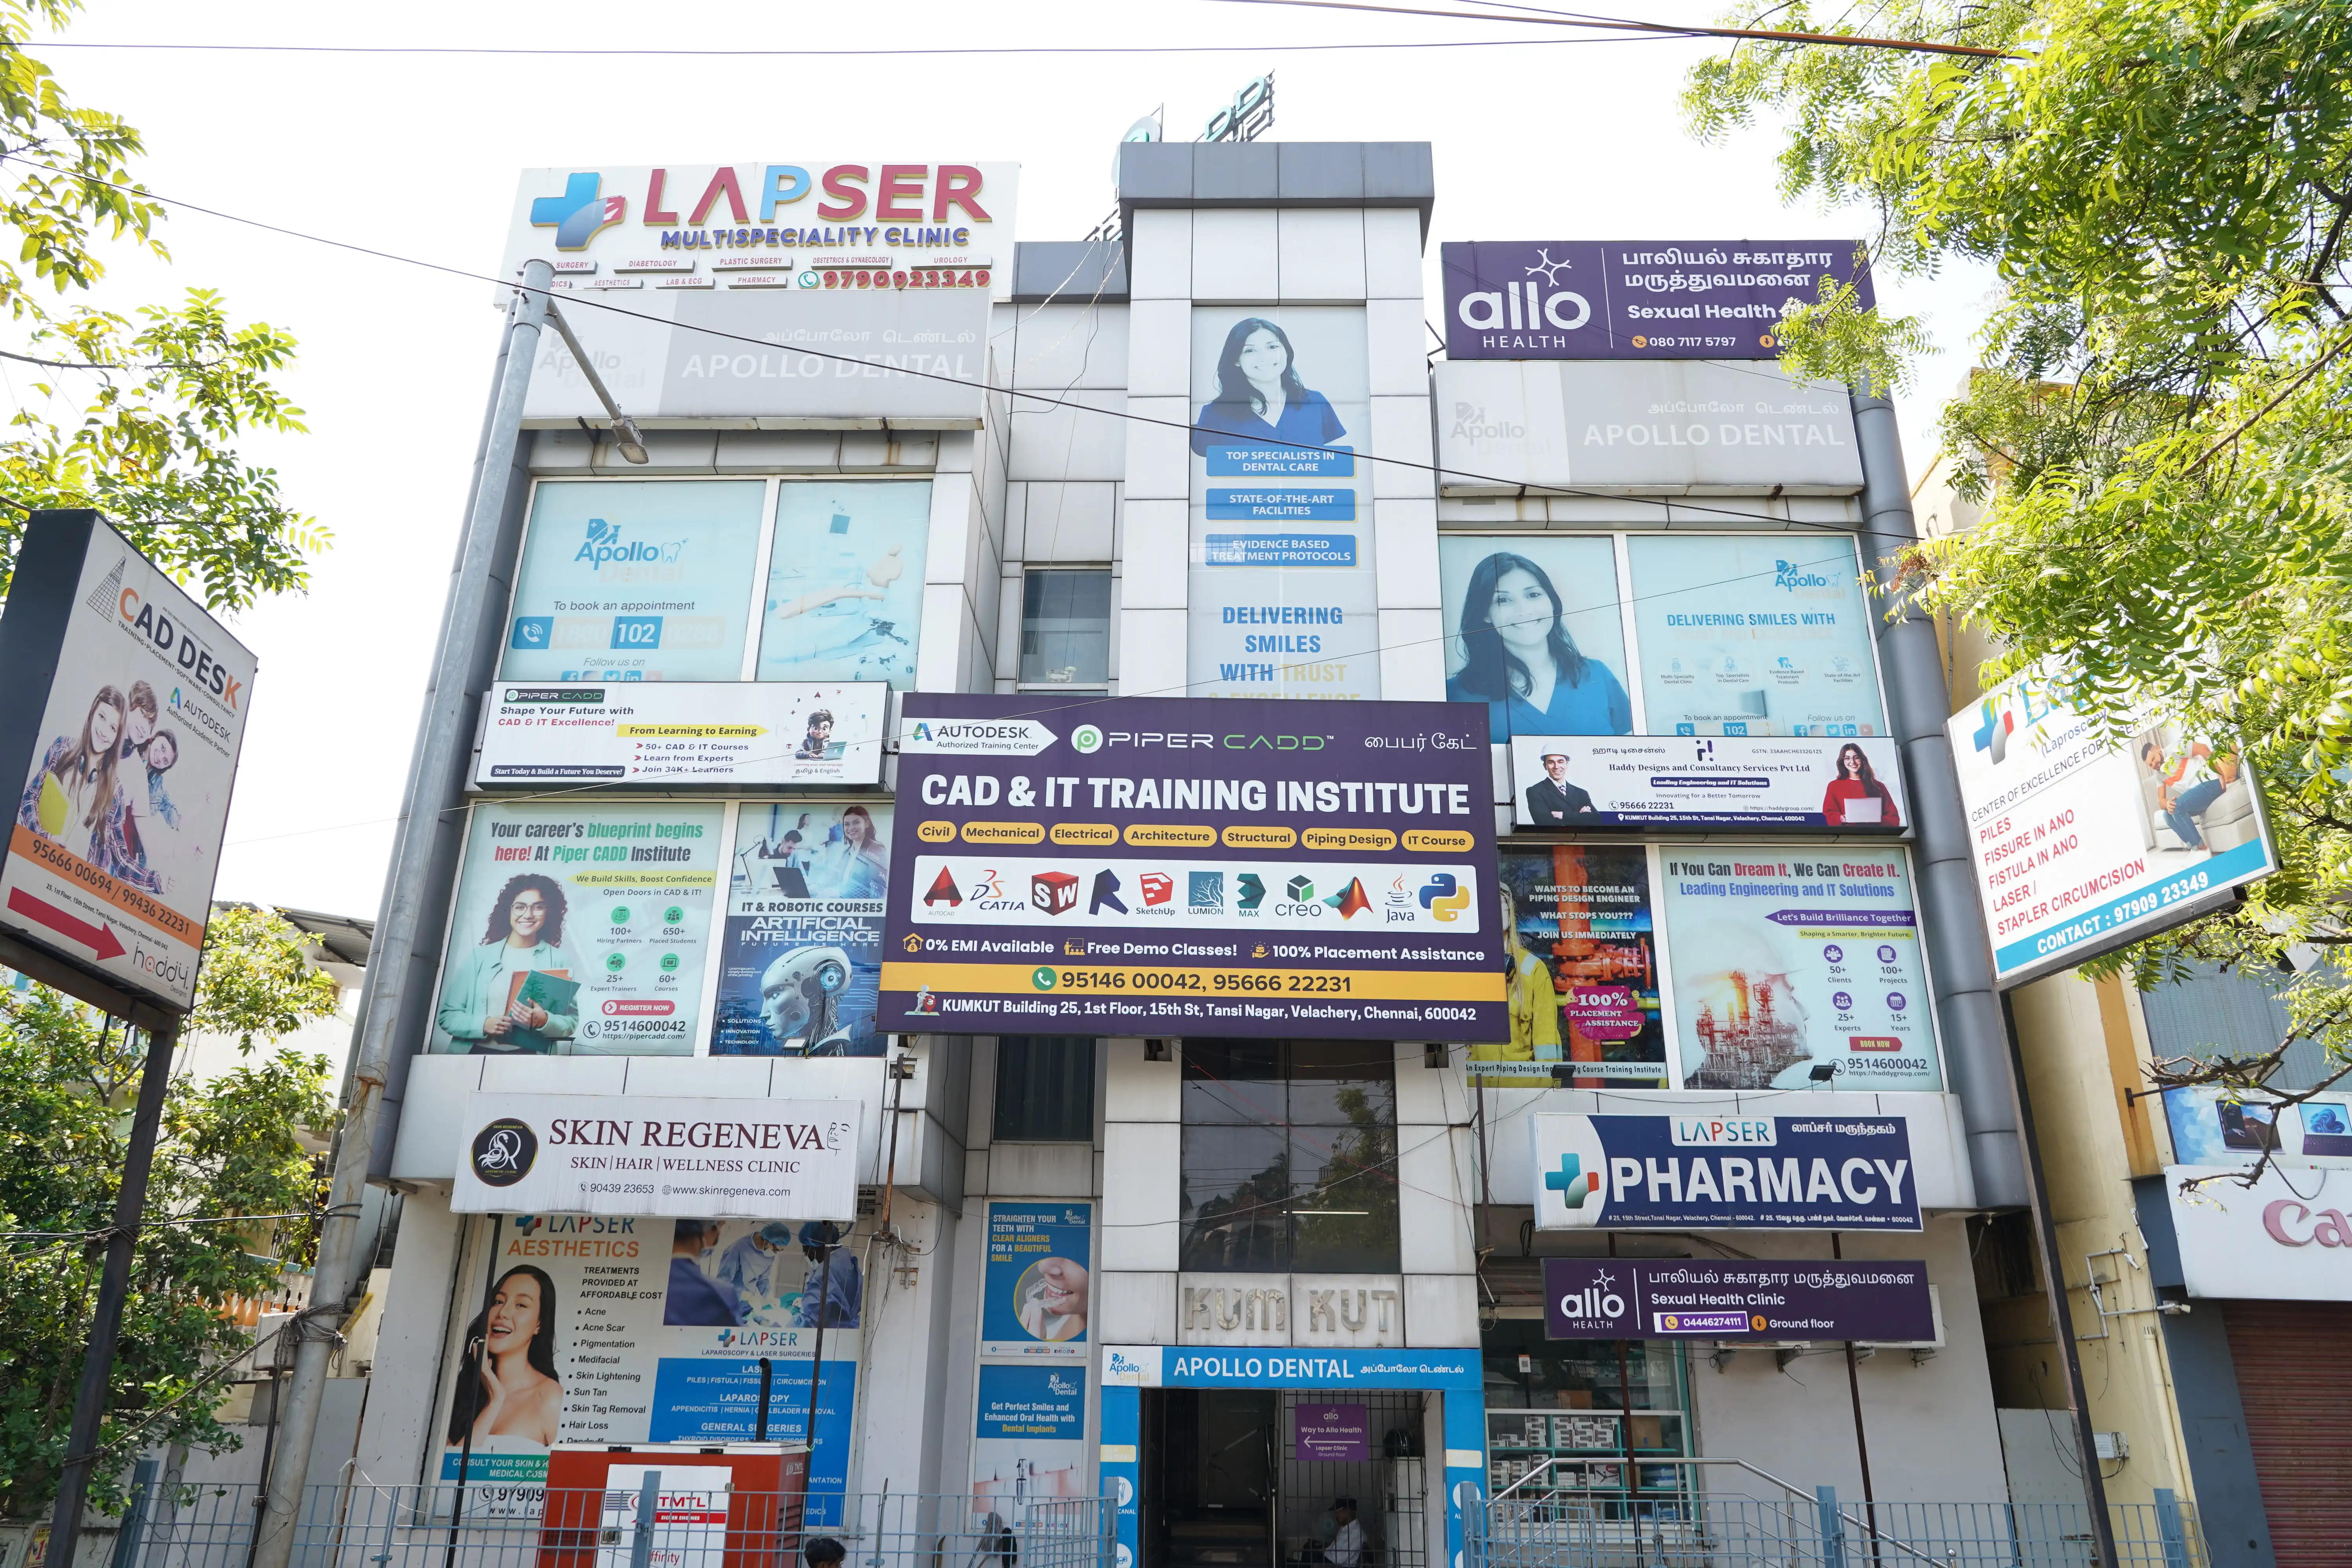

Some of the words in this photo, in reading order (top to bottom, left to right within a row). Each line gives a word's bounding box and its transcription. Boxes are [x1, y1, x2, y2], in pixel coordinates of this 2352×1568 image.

[643, 165, 992, 227] LAPSER
[661, 227, 879, 250] MULTISPECIALITY
[885, 227, 969, 247] CLINIC
[1623, 248, 1727, 264] பாலியல்
[1733, 253, 1832, 270] சுகாதார
[824, 270, 989, 291] 9790923349
[1625, 270, 1810, 292] மருத்துவமனை
[1459, 282, 1590, 329] allo
[1628, 305, 1700, 318] Sexual
[1705, 304, 1776, 318] Health
[1483, 336, 1565, 348] HEALTH
[1650, 338, 1674, 347] 080
[1678, 338, 1701, 346] 7117
[1705, 337, 1735, 346] 5797
[1223, 607, 1342, 624] DELIVERING
[619, 624, 655, 642] 102
[120, 588, 173, 650] CAD
[178, 635, 242, 710] DESK
[1245, 635, 1320, 653] SMILES
[1220, 664, 1273, 681] WITH
[1281, 664, 1347, 682] TRUST
[183, 700, 230, 743] AUTODESK
[167, 706, 192, 730] Authorized
[192, 725, 214, 746] Academic
[214, 742, 230, 758] Partner
[659, 727, 702, 736] Learning
[719, 727, 757, 737] Earning
[1109, 733, 1213, 748] PIPER
[1365, 733, 1426, 752] பைபர்
[1432, 733, 1477, 749] கேட்
[1639, 764, 1670, 772] Designs
[1690, 764, 1740, 773] Consultancy
[922, 775, 999, 805] CAD
[1008, 776, 1036, 806] &
[1045, 777, 1079, 807] IT
[1088, 778, 1266, 811] TRAINING
[1277, 781, 1470, 814] INSTITUTE
[492, 822, 522, 837] Your
[588, 822, 652, 840] blueprint
[655, 822, 703, 839] begins
[922, 827, 949, 836] Civil
[966, 828, 1039, 837] Mechanical
[1055, 829, 1112, 838] Electrical
[1131, 831, 1209, 840] Architecture
[1228, 833, 1290, 842] Structural
[1307, 833, 1345, 846] Piping
[1349, 835, 1391, 847] Design
[1408, 836, 1418, 844] IT
[1422, 837, 1465, 845] Course
[1980, 817, 2012, 844] PILES
[1984, 832, 2032, 866] FISSURE
[2034, 826, 2046, 841] IN
[2049, 808, 2074, 832] ANO
[1670, 862, 1678, 875] If
[1681, 863, 1704, 875] You
[1708, 863, 1731, 876] Can
[1734, 863, 1775, 876] Dream
[1778, 864, 1791, 878] It,
[1793, 863, 1813, 877] We
[1817, 863, 1840, 877] Can
[1843, 864, 1884, 877] Create
[1887, 864, 1900, 877] It.
[33, 840, 72, 871] 95666
[75, 863, 112, 893] 00694
[123, 889, 155, 917] 99436
[158, 911, 189, 935] 22231
[1997, 902, 2048, 936] STAPLER
[2052, 858, 2145, 913] CIRCUMCISION
[742, 902, 753, 911] IT
[756, 902, 765, 912] &
[769, 902, 823, 912] ROBOTIC
[827, 903, 883, 912] COURSES
[980, 901, 1024, 910] CATIA
[1136, 907, 1175, 916] SketchUp
[1275, 904, 1321, 916] creo
[1387, 909, 1414, 923] Java
[2038, 915, 2102, 954] CONTACT
[2114, 893, 2158, 924] 97909
[2161, 871, 2209, 904] 23349
[750, 917, 871, 929] ARTIFICIAL
[741, 931, 880, 942] INTELLIGENCE
[171, 984, 187, 997] Designs
[1579, 993, 1628, 1006] 100%
[604, 1021, 685, 1031] 9514600042
[1585, 1019, 1639, 1027] ASSISTANCE
[549, 1119, 633, 1146] SKIN
[641, 1122, 825, 1149] REGENEVA
[1681, 1122, 1770, 1142] LAPSER
[590, 1183, 621, 1192] 90439
[624, 1184, 654, 1193] 23653
[673, 1186, 790, 1197] www.skinregeneva.com
[1611, 1158, 1907, 1204] PHARMACY
[507, 1240, 639, 1257] AESTHETICS
[1561, 1289, 1624, 1318] allo
[1651, 1293, 1696, 1304] Sexual
[1700, 1294, 1744, 1305] Health
[1747, 1293, 1785, 1305] Clinic
[1184, 1287, 1284, 1330] KUM
[1309, 1289, 1395, 1332] KUT
[1684, 1318, 1741, 1326] 04446274111
[1769, 1319, 1808, 1328] Ground
[1810, 1319, 1834, 1328] floor
[581, 1339, 635, 1349] Pigmentation
[740, 1332, 797, 1346] LAPSER
[1174, 1357, 1261, 1377] APOLLO
[1269, 1359, 1354, 1377] DENTAL
[1361, 1364, 1417, 1373] அப்போலோ
[1420, 1364, 1464, 1373] டெண்டல்
[597, 1372, 641, 1382] Lightening
